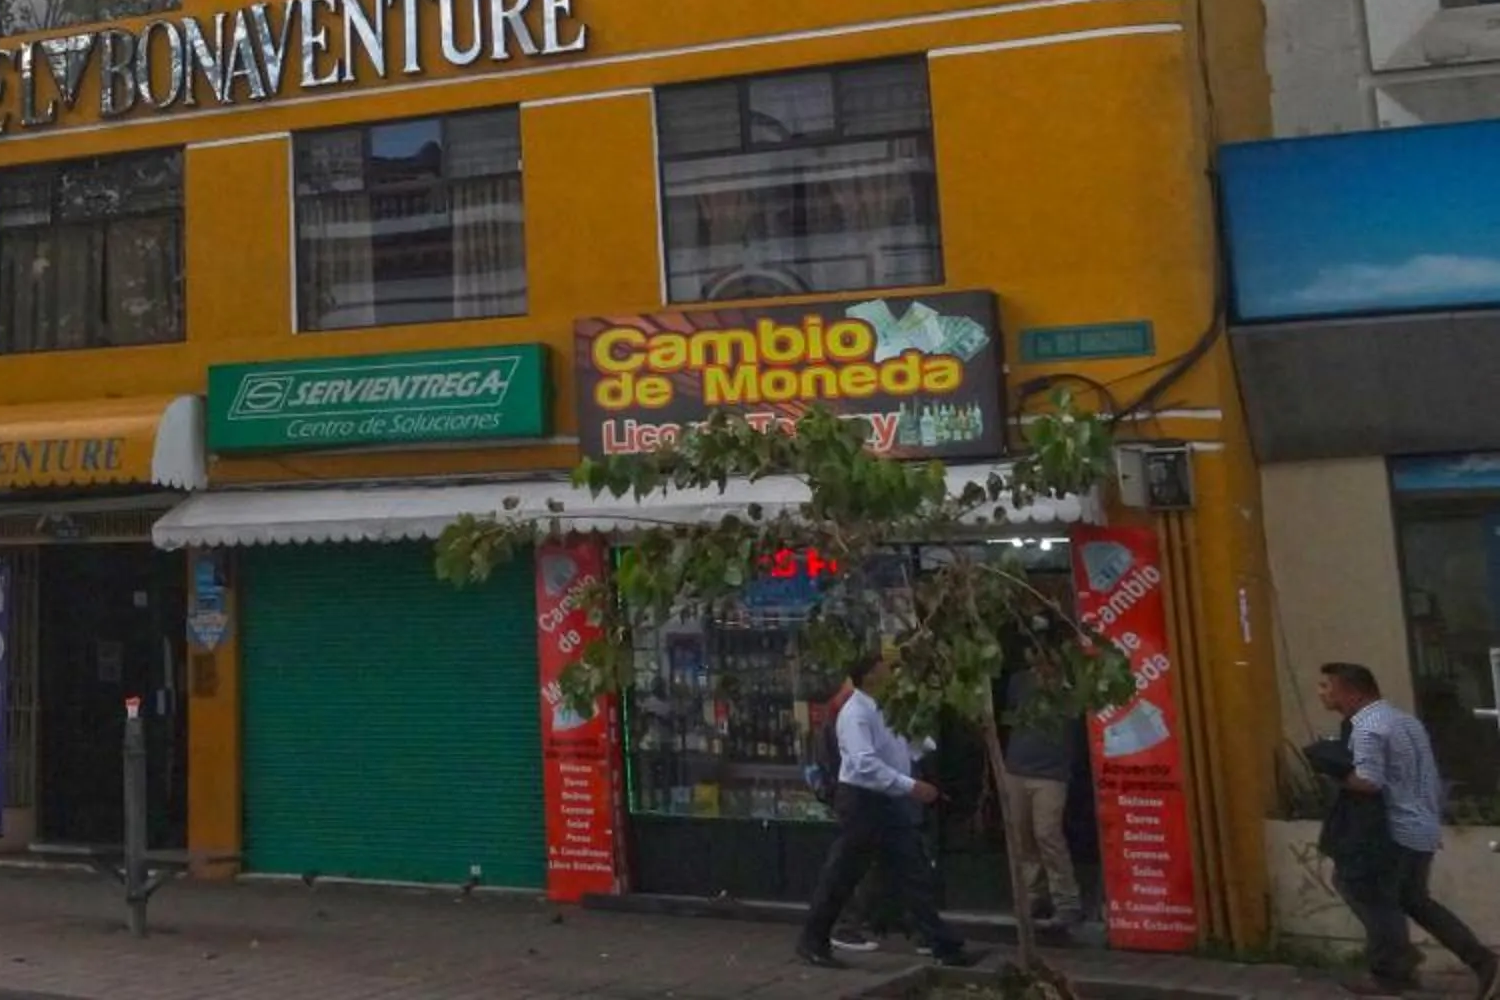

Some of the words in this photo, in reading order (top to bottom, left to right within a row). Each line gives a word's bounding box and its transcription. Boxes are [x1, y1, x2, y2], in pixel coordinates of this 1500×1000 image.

[593, 313, 875, 373] Cambio
[288, 368, 504, 406] SERVIENTREGA
[594, 370, 674, 409] de
[702, 350, 965, 405] Moneda
[286, 418, 352, 439] Centro
[358, 415, 383, 435] de
[388, 411, 504, 434] Soluciones
[1081, 564, 1161, 633] Cambio
[558, 629, 581, 653] de
